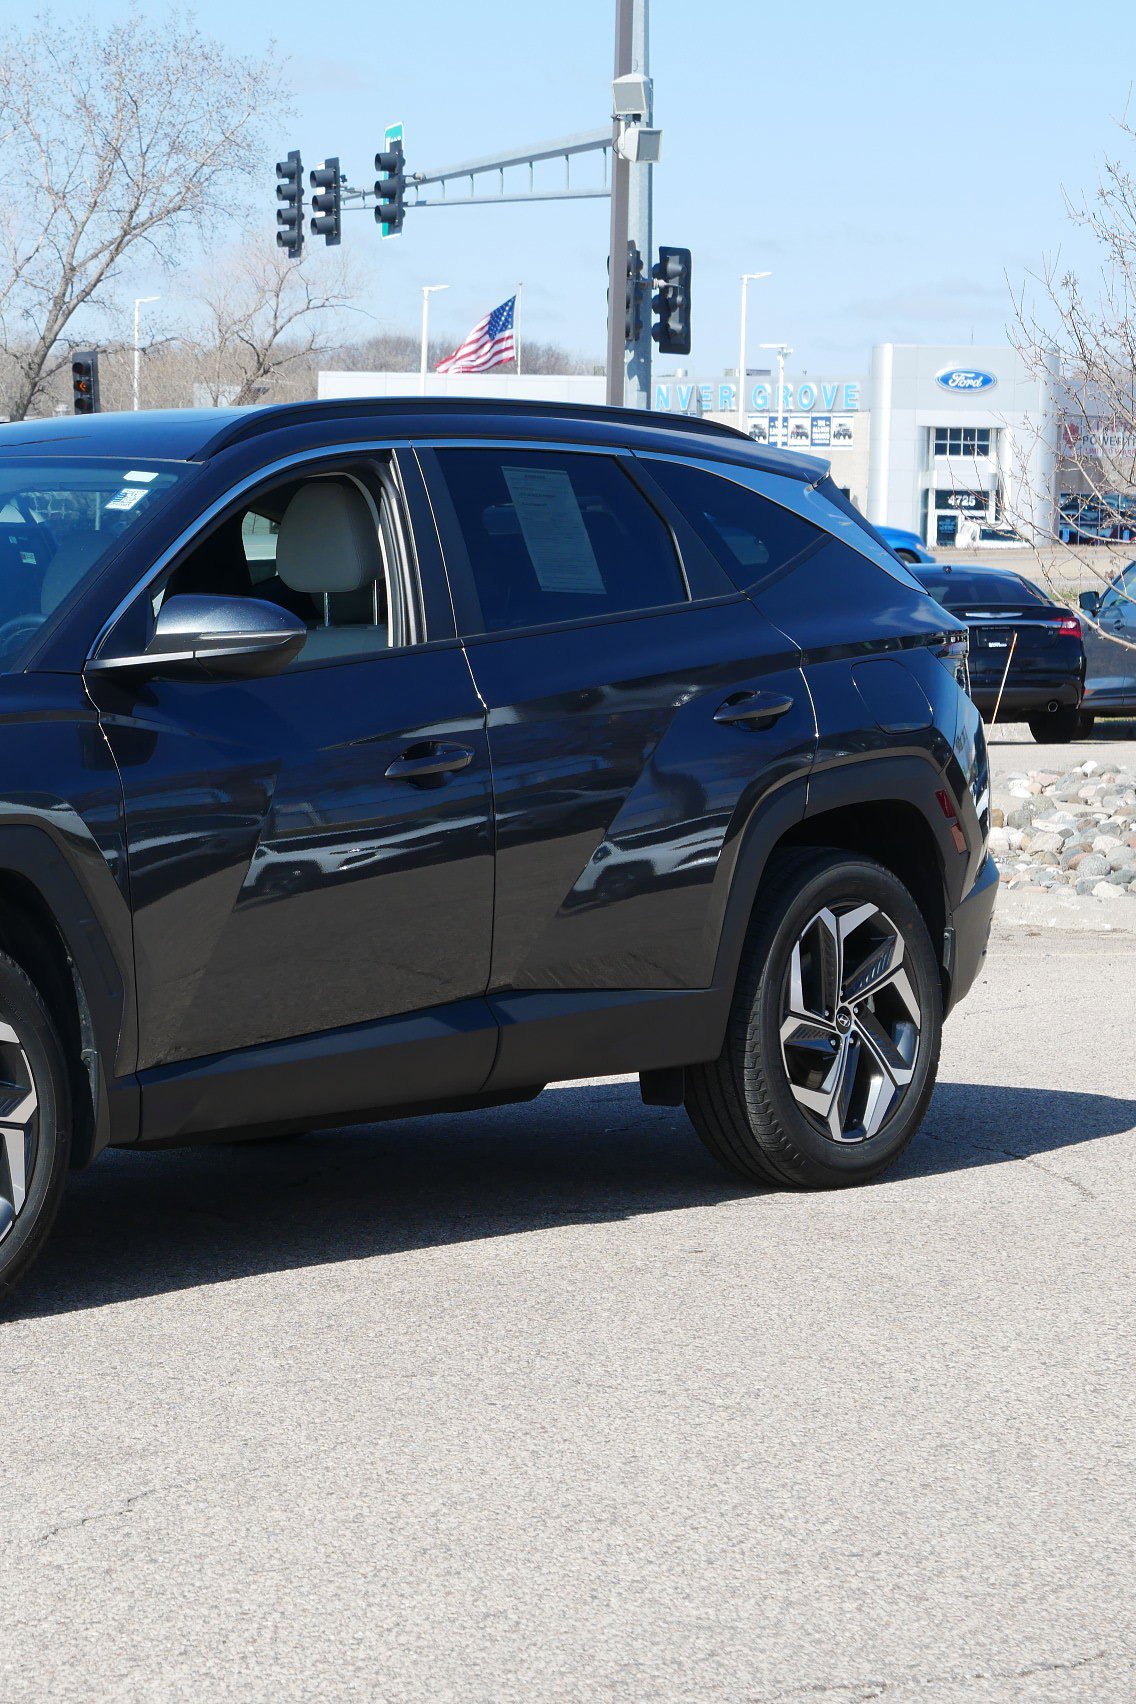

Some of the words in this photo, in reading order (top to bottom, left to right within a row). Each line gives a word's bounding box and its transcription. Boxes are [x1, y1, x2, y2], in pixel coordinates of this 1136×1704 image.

[948, 372, 984, 388] Ford
[752, 384, 859, 410] GROVE
[947, 495, 976, 506] 4725
